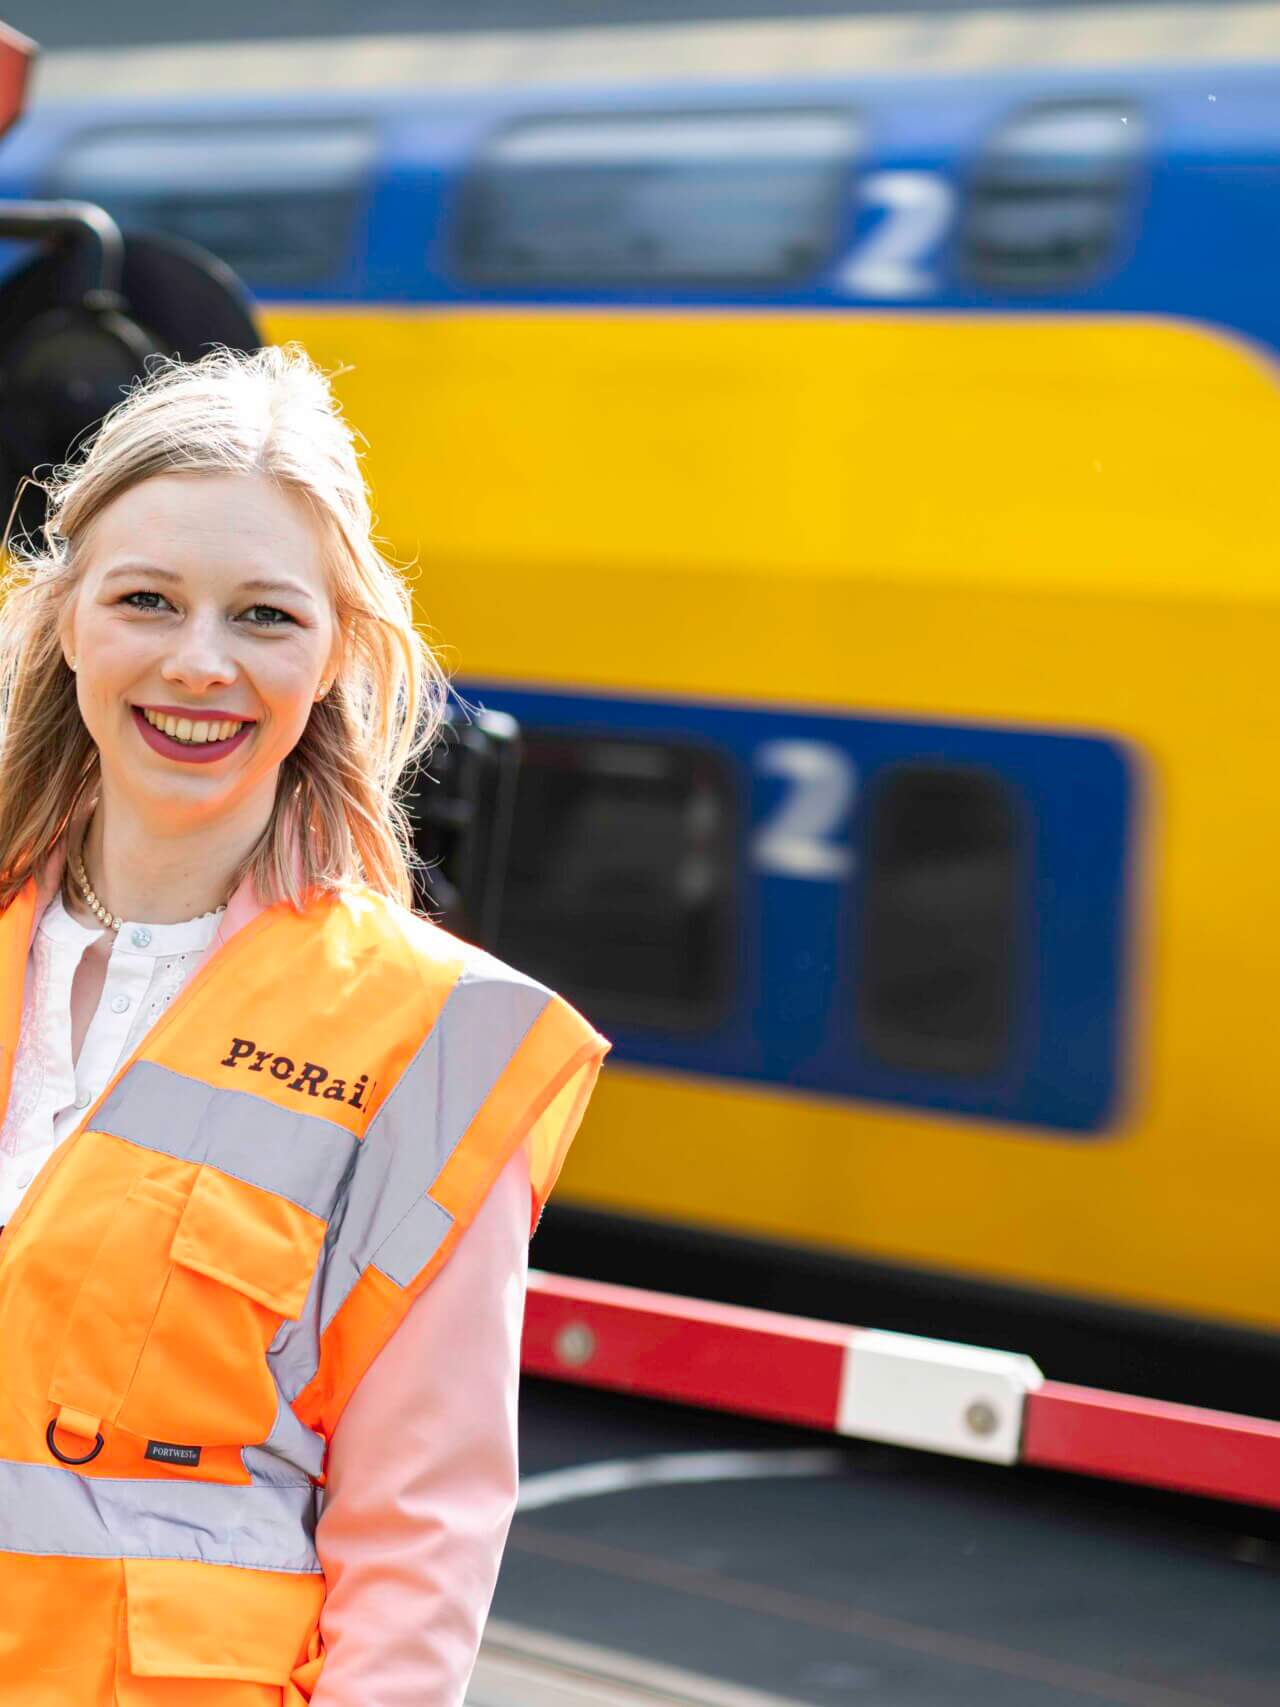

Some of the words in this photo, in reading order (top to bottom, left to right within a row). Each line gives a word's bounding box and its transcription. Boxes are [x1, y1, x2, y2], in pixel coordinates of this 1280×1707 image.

[842, 171, 956, 298] 2
[755, 738, 857, 878] 2
[221, 1037, 377, 1113] ProRai
